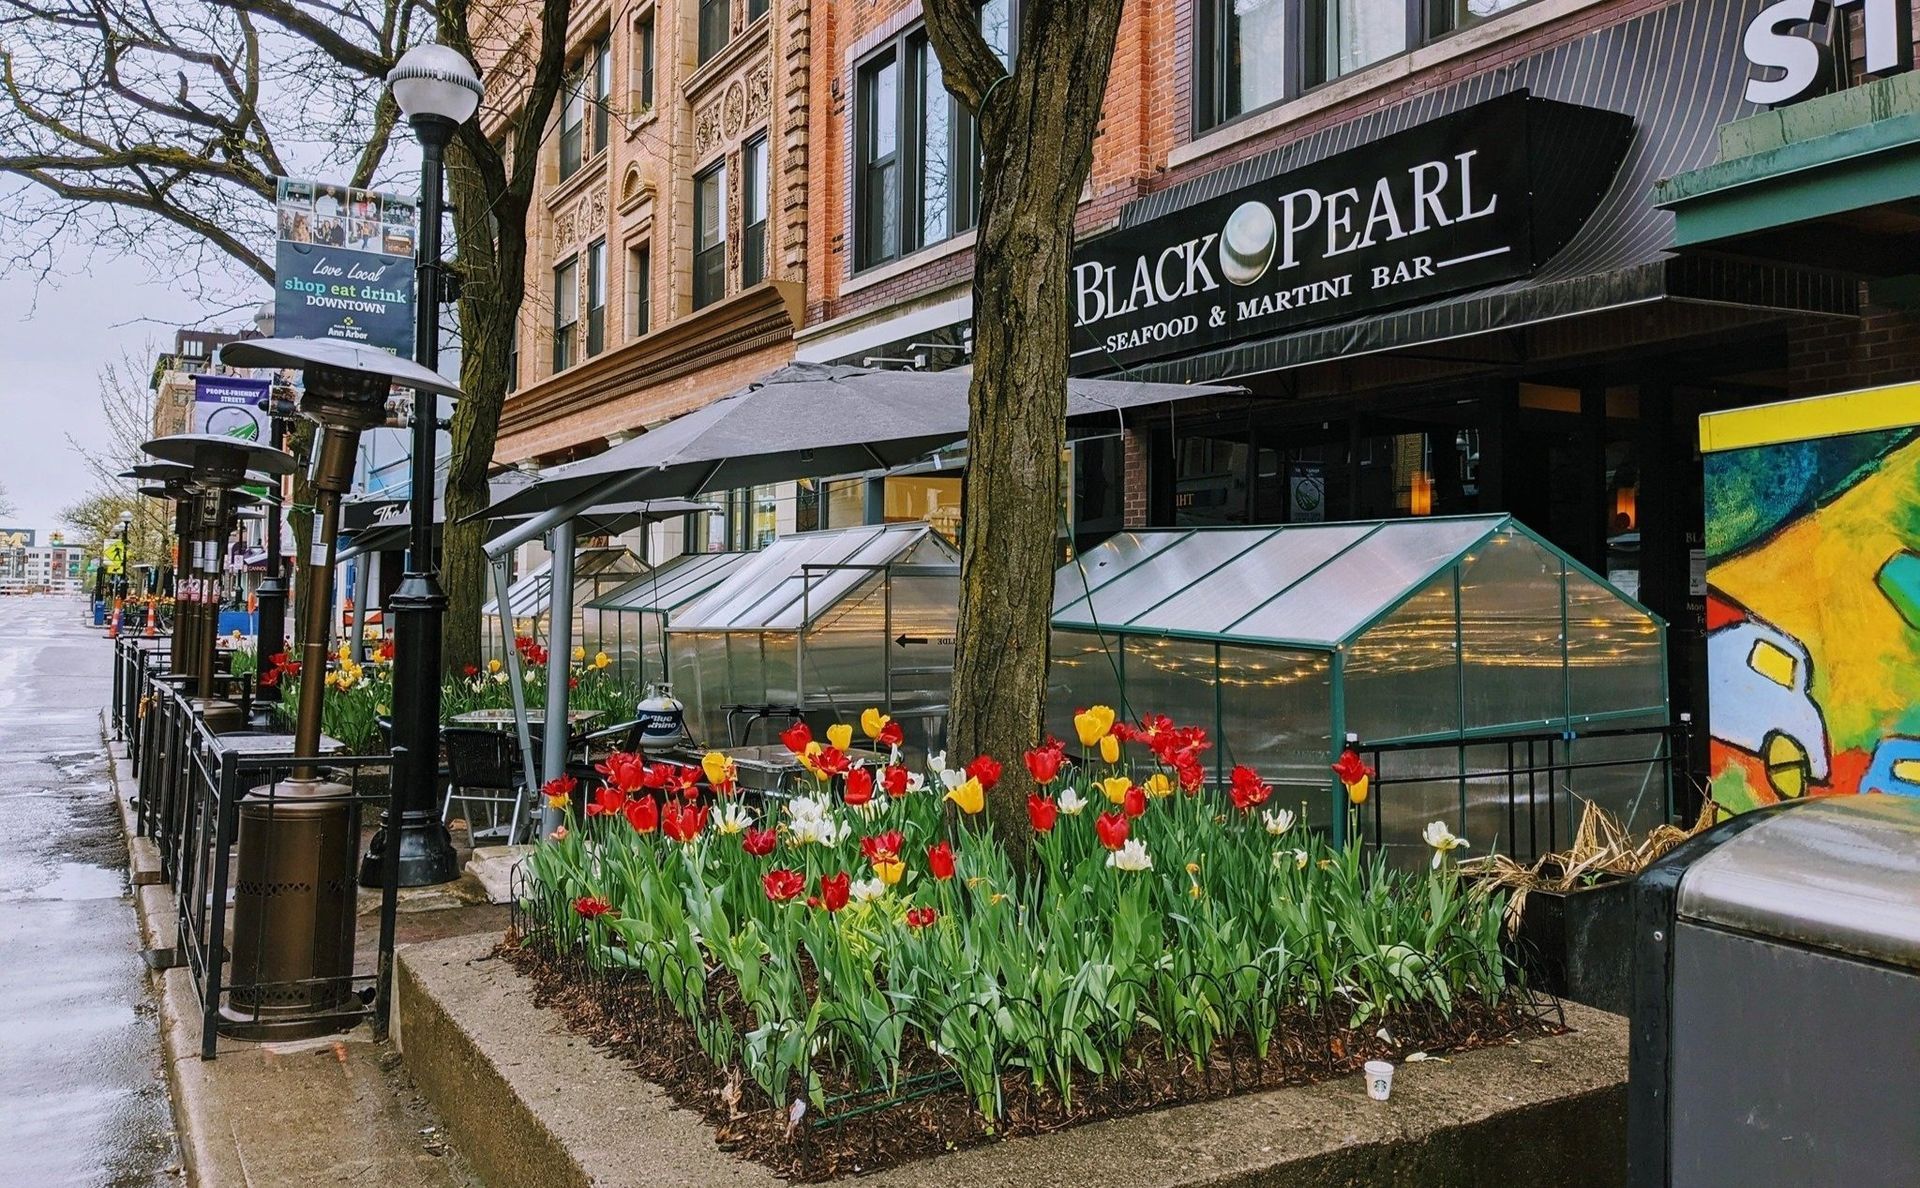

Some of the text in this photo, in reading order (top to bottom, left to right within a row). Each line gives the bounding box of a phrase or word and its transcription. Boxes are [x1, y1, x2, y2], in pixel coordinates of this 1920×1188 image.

[1073, 149, 1498, 327] BLACK PEARL
[312, 257, 386, 282] Love Local
[284, 277, 407, 304] shop eat drink
[306, 295, 386, 314] DOWNTOWN
[1106, 256, 1435, 354] SEAFOOD & MARTINI BAR
[327, 327, 368, 340] Ann Arbor
[205, 388, 260, 398] PEOPLE-FRIENDLY
[220, 396, 245, 404] STREETS
